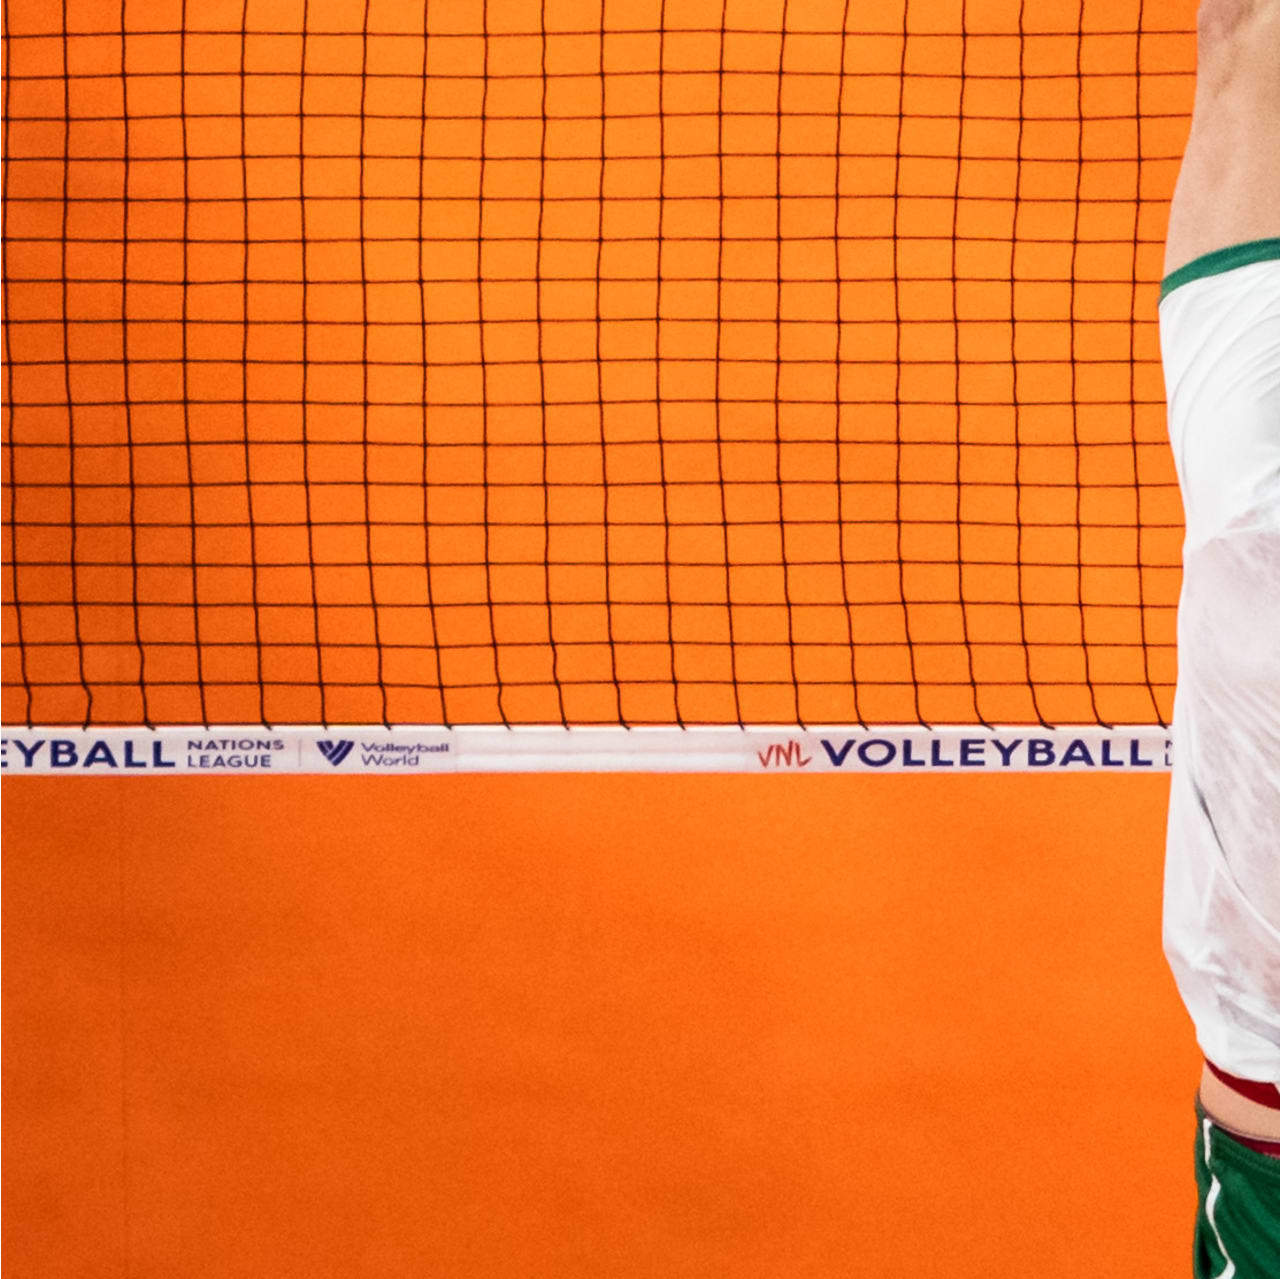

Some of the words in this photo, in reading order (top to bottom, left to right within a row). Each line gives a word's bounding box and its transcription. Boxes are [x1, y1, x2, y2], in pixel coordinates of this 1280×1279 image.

[187, 739, 285, 751] NATIONS
[361, 742, 450, 754] Volleyball
[1, 739, 176, 768] YBALL
[361, 754, 420, 766] World
[757, 739, 812, 768] VNL
[821, 739, 1153, 767] VOLLEYBALL
[187, 754, 272, 768] LEAGUE
